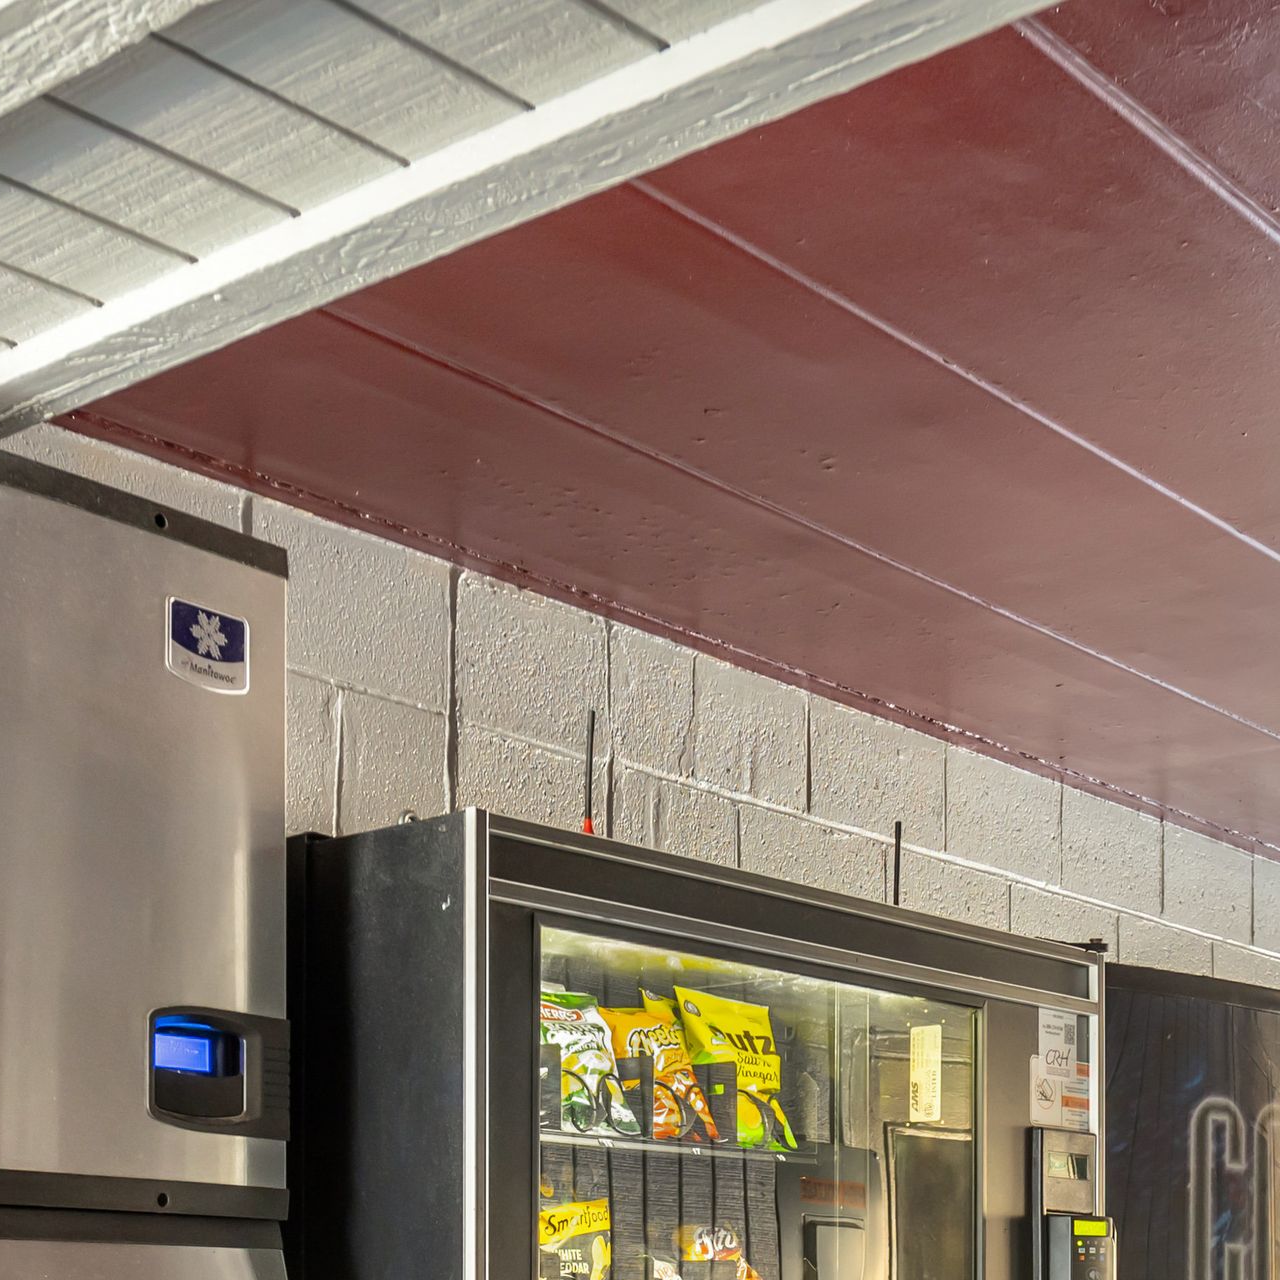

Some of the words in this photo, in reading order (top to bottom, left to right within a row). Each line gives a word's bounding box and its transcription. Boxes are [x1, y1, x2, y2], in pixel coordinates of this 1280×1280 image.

[190, 661, 234, 684] Manitowoc
[1046, 1048, 1071, 1067] CRH
[545, 1205, 609, 1236] Smartfood
[560, 1262, 590, 1274] EDDAR
